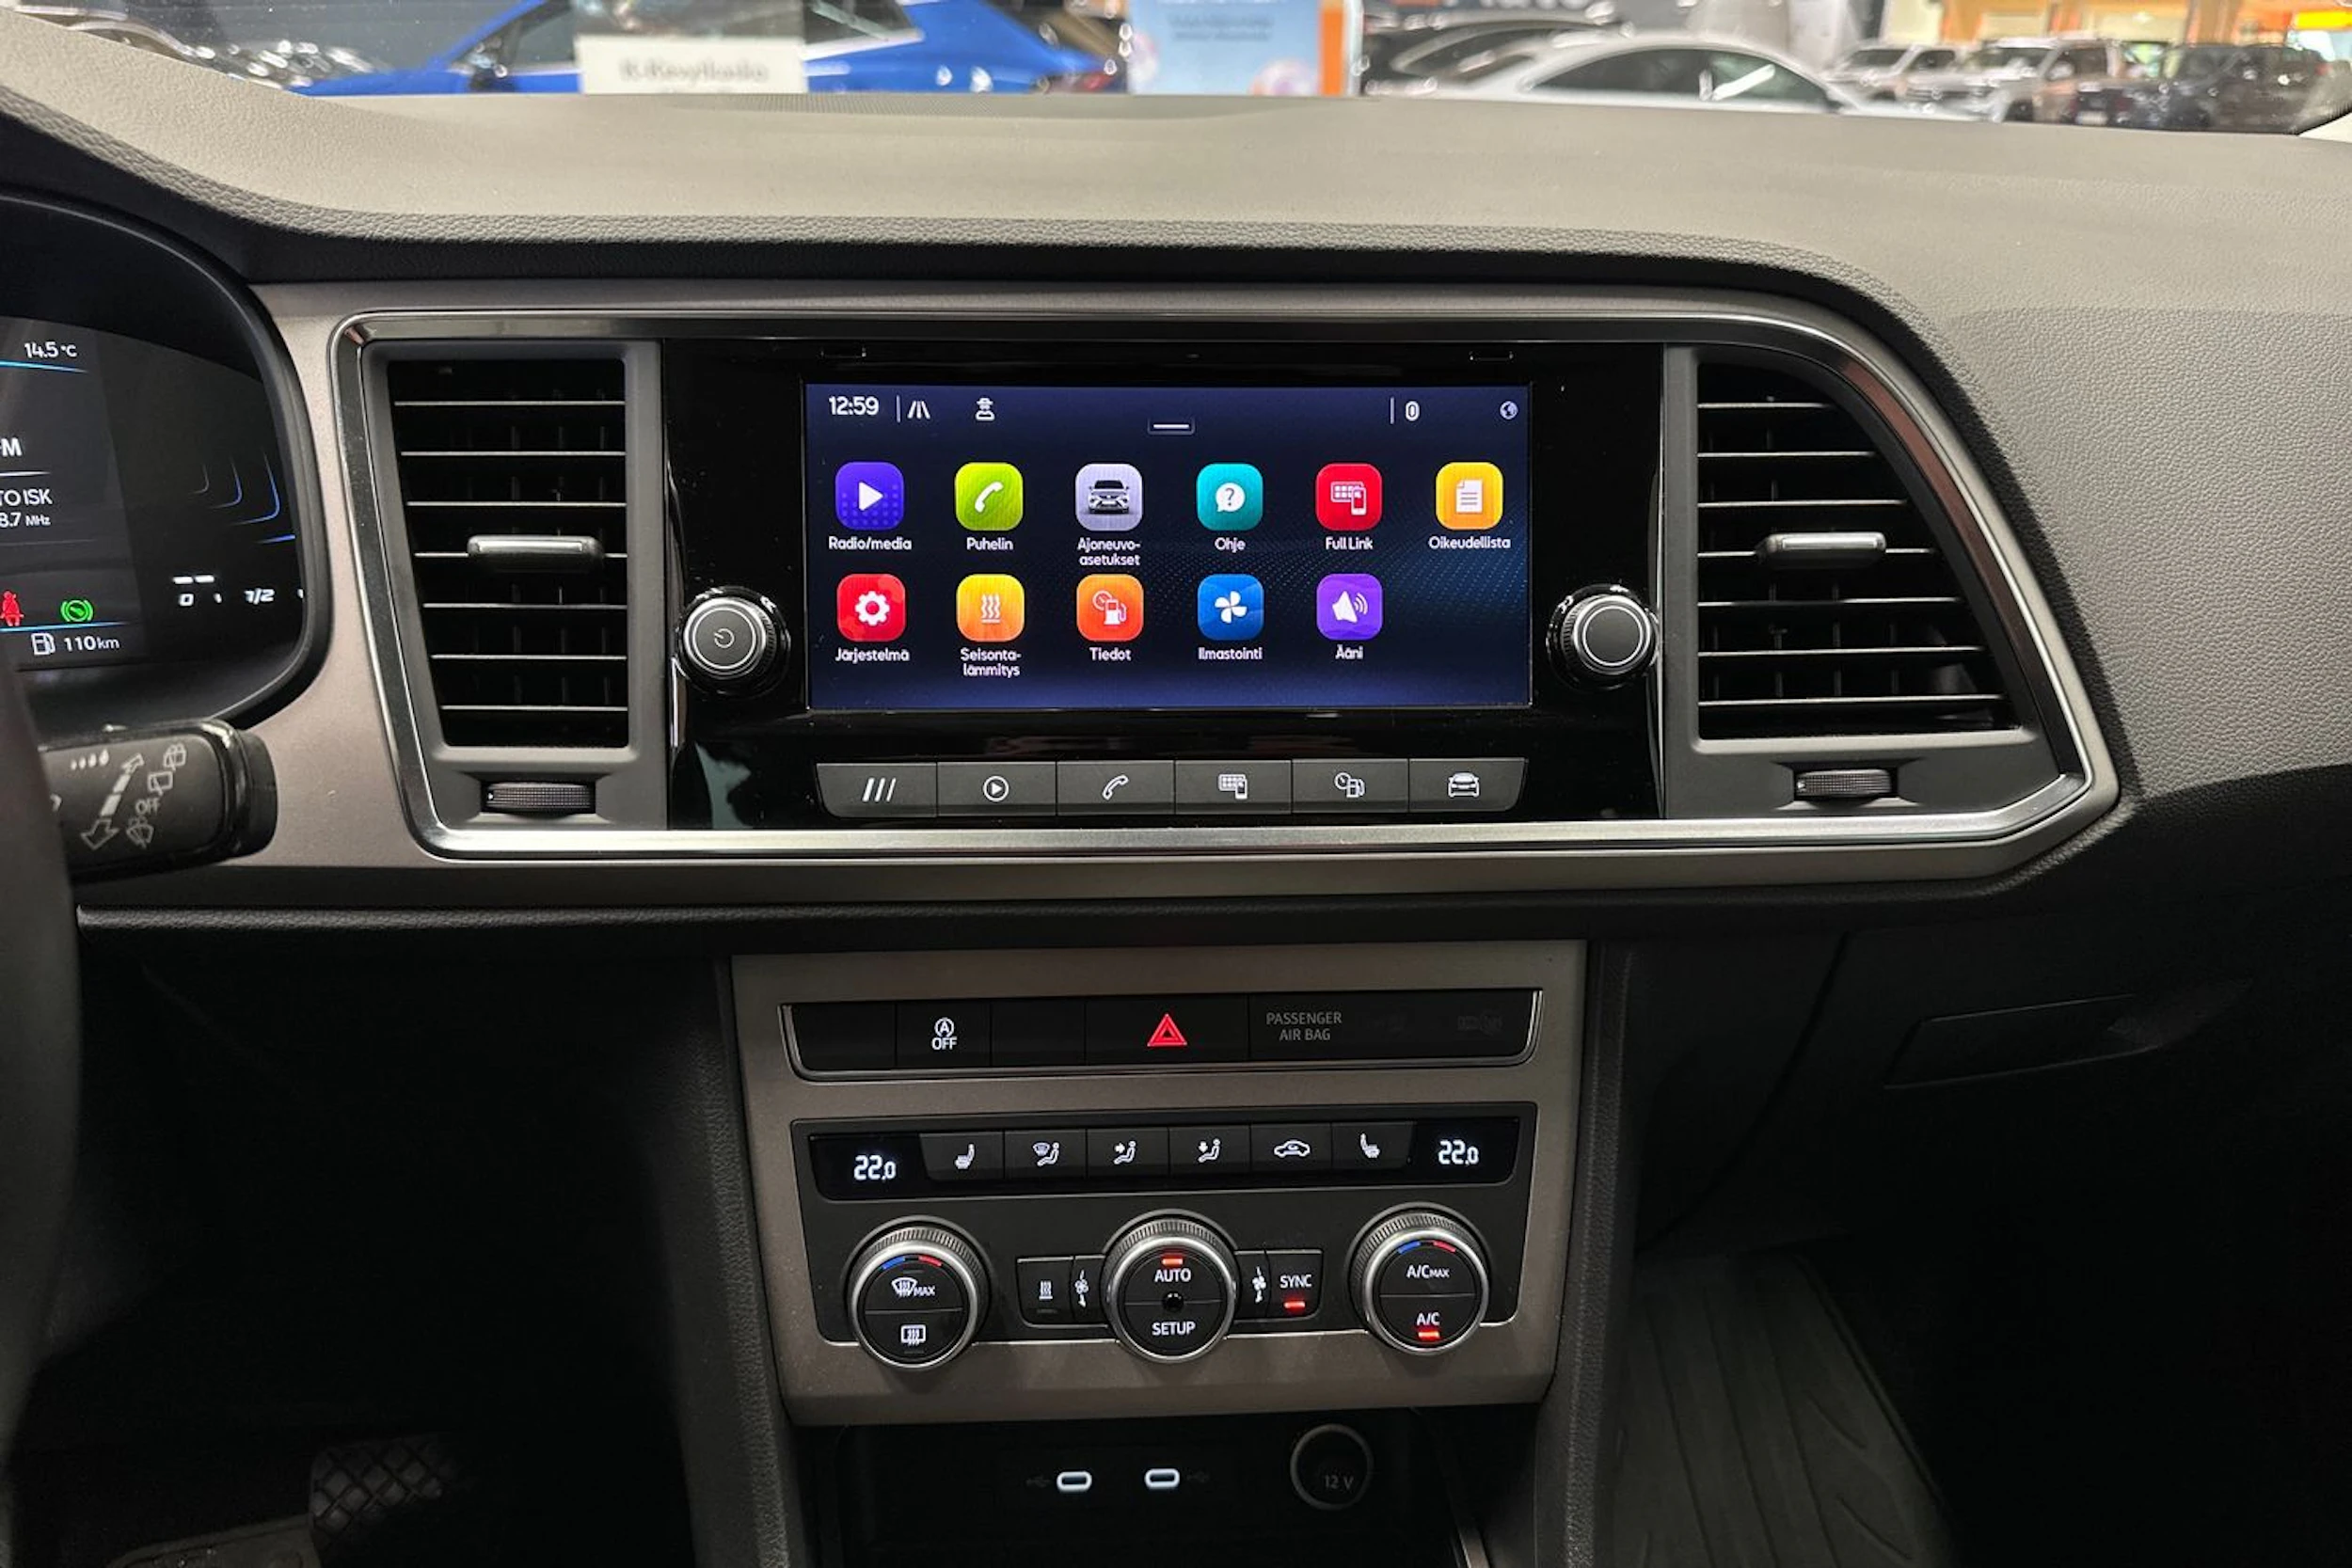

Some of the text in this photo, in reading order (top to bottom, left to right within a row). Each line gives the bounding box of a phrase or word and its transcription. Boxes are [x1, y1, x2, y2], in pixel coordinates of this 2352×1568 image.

[24, 341, 58, 358] 14.5
[828, 396, 880, 416] 12:59
[0, 437, 23, 457] M
[23, 488, 53, 506] ISK
[25, 514, 52, 527] MHz
[828, 536, 913, 550] Radio/media
[966, 537, 1014, 551] Puhelin
[1077, 537, 1141, 552] Ajoneuvo-
[1215, 537, 1246, 552] Ohje
[1325, 536, 1374, 550] Full Link
[1428, 535, 1511, 550] Oikeudellista
[1079, 553, 1140, 566] asetukset
[244, 587, 275, 605] 1/2
[834, 648, 910, 662] Järjestelmä
[960, 648, 1022, 661] Seisonta-
[1089, 648, 1132, 661] Tiedot
[1198, 646, 1263, 660] Ilmastointi
[1335, 644, 1363, 659] Ääni
[962, 663, 1020, 678] lämmitys
[135, 797, 160, 816] OFF
[1265, 1011, 1343, 1025] PASSENGER
[1279, 1028, 1331, 1041] AIR BAG
[931, 1037, 957, 1051] OFF
[1154, 1268, 1192, 1283] AUTO
[1279, 1274, 1312, 1289] SYNC
[914, 1286, 936, 1297] MAX
[1416, 1311, 1440, 1326] A/C
[1152, 1321, 1197, 1337] SETUP
[1325, 1474, 1355, 1491] 12 V
